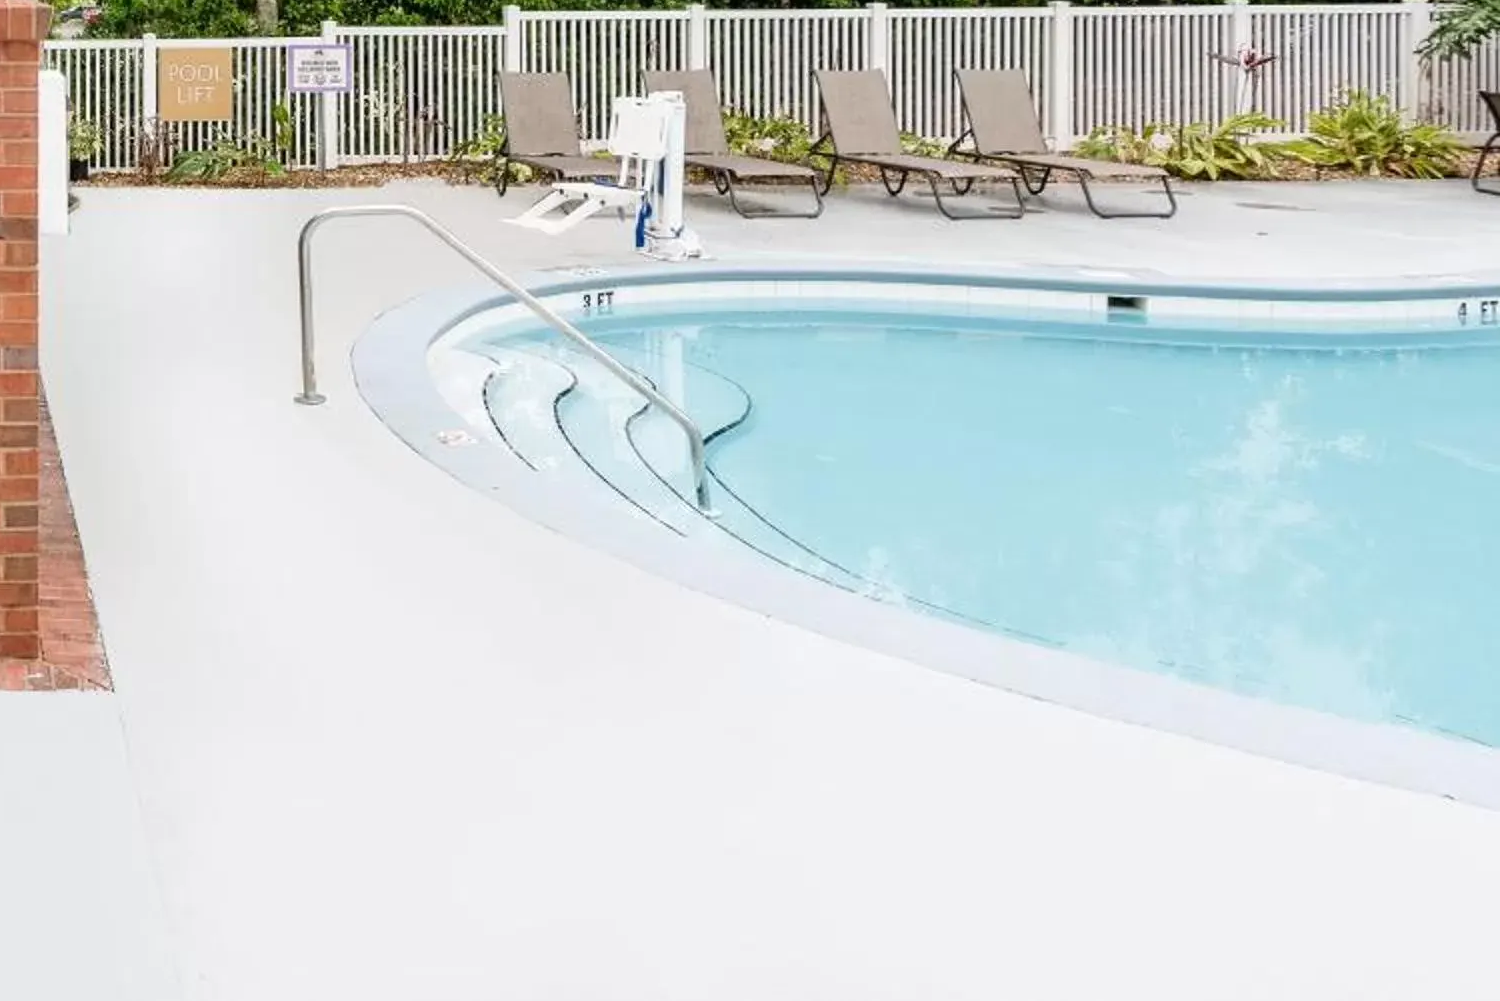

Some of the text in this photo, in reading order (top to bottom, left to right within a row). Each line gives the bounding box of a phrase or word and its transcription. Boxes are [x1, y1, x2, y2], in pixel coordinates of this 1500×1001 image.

[168, 64, 222, 82] POOL
[177, 85, 216, 104] LIFT
[582, 291, 614, 308] 3 FT
[1481, 300, 1499, 316] FT
